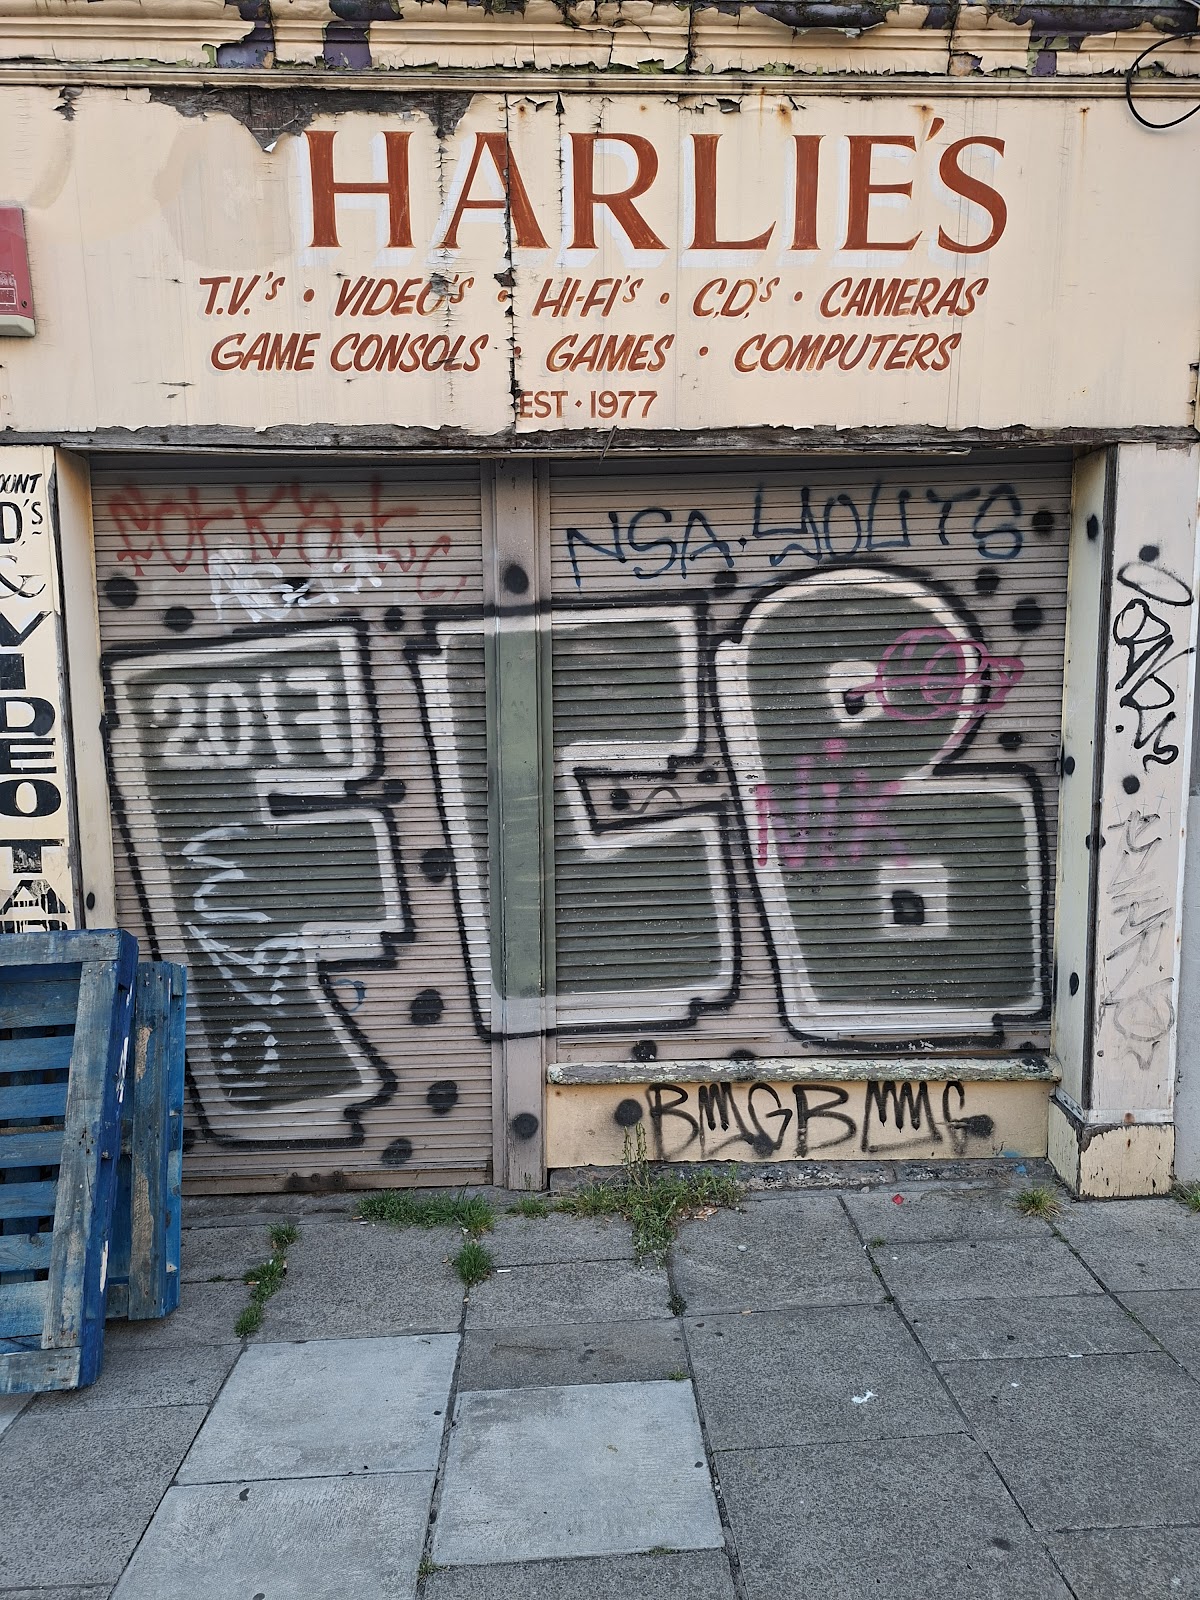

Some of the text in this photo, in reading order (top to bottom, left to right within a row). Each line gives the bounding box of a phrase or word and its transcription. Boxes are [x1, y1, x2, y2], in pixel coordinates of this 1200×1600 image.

[304, 117, 1008, 254] HARLIE'S
[820, 277, 989, 318] CAMERAS
[210, 332, 963, 373] GAME CONSOLS GAMES COMPUTERS
[518, 389, 658, 419] EST 1977
